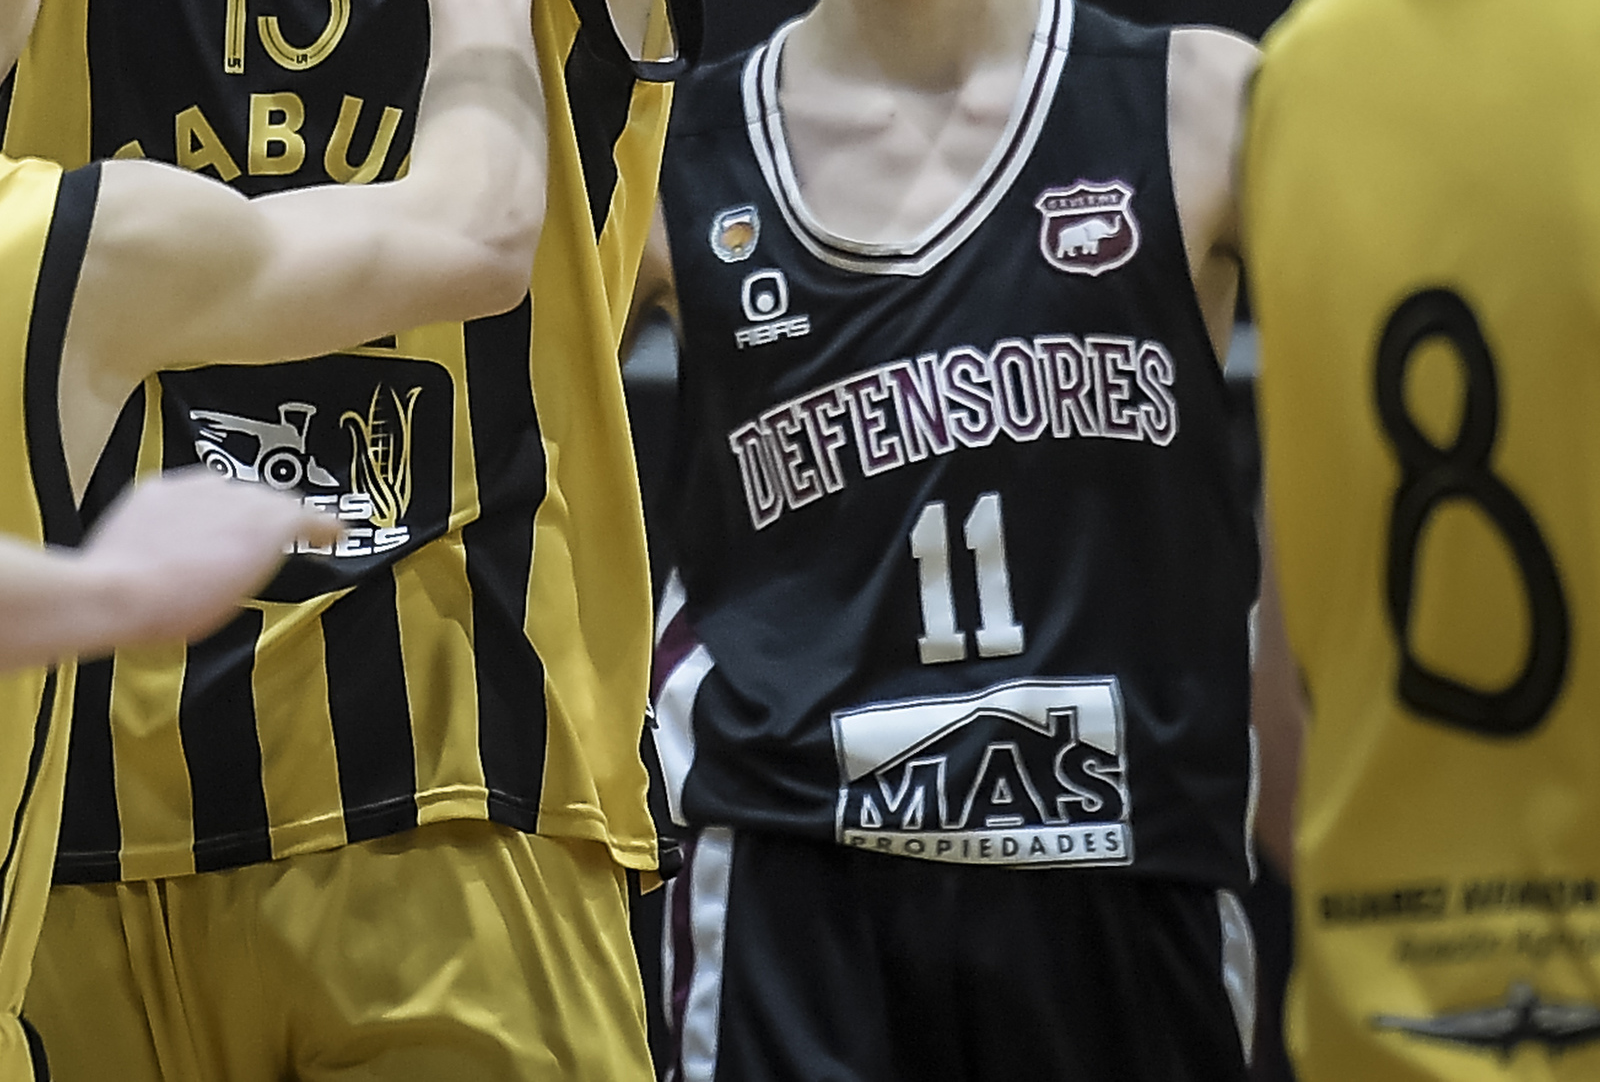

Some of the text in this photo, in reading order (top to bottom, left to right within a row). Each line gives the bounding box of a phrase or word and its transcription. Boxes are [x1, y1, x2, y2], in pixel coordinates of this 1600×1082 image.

[112, 92, 411, 183] ABU
[729, 335, 1179, 531] DEFENSORES
[909, 491, 1025, 665] 11
[1370, 286, 1571, 740] 8
[838, 740, 1130, 831] MAS
[848, 830, 1121, 861] PROPIEDADES
